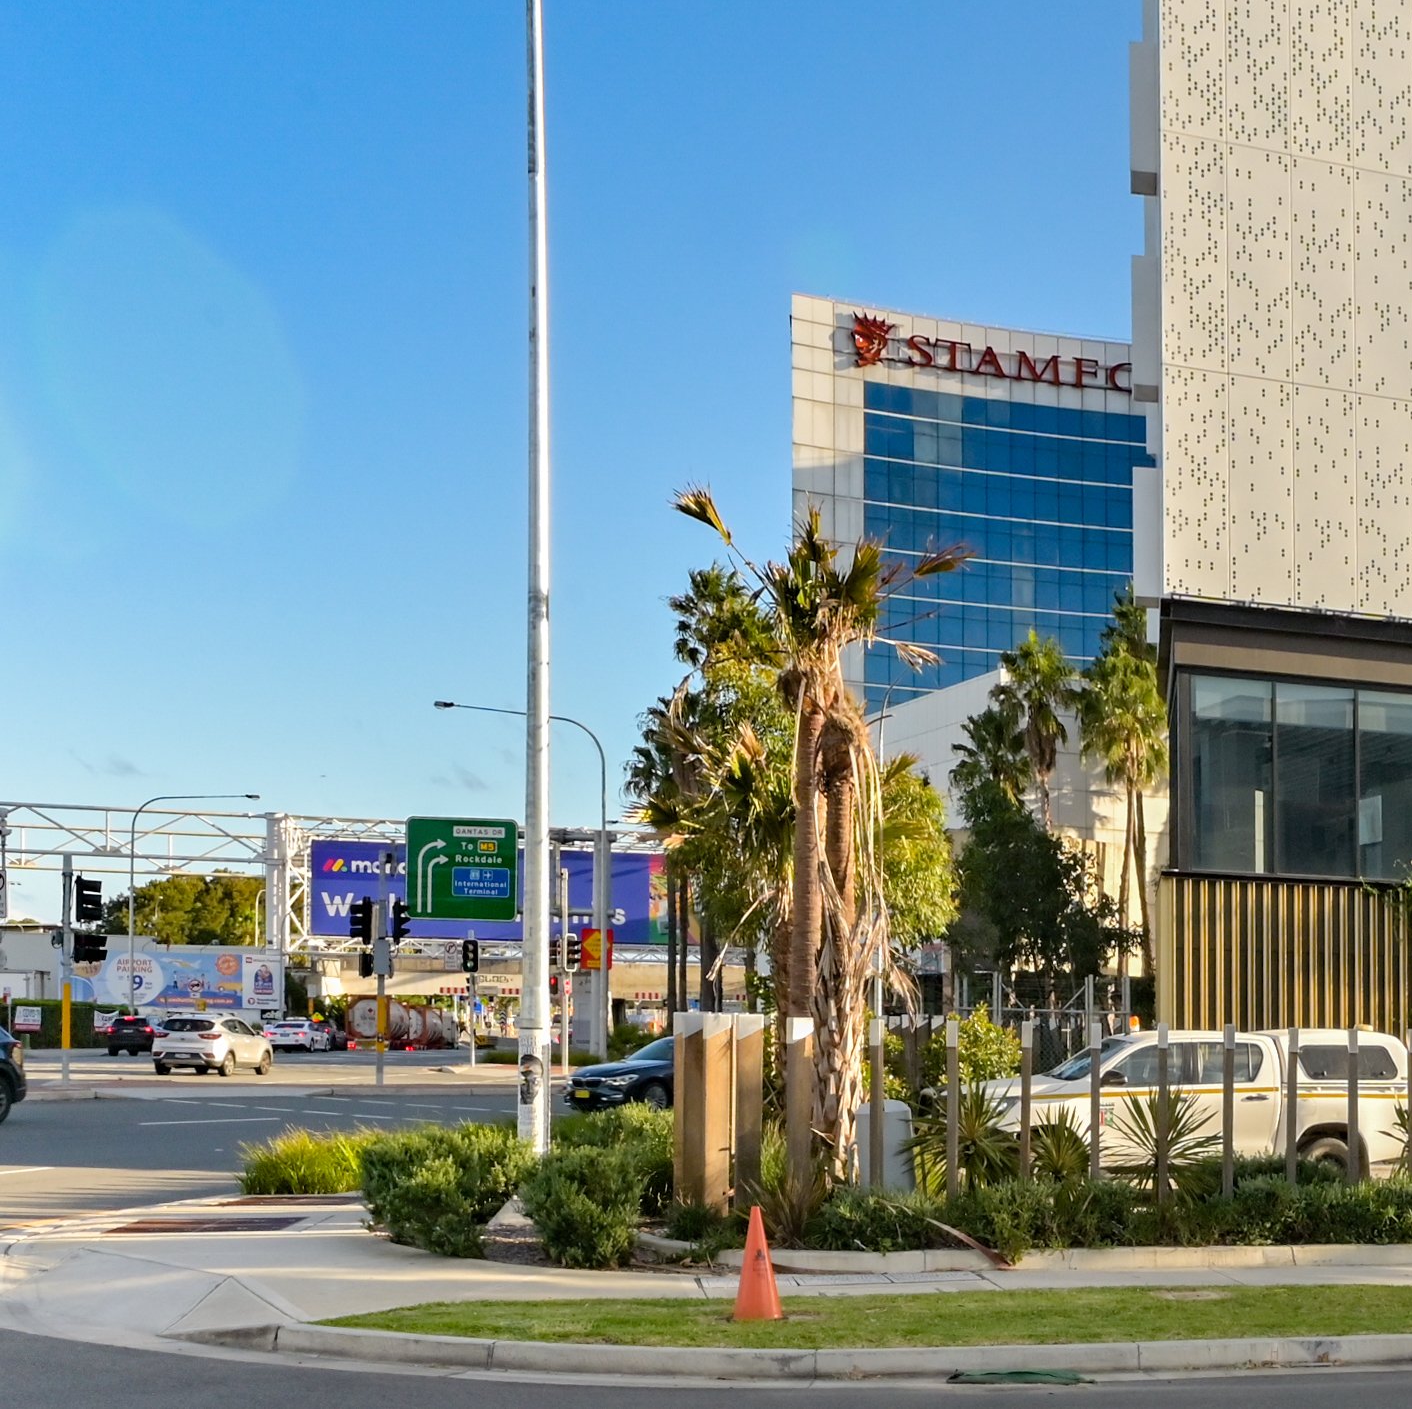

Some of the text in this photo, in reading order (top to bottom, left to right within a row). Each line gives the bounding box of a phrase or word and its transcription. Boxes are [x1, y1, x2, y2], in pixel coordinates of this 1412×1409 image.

[461, 842, 495, 851] To M5
[455, 854, 503, 864] Rockdale
[455, 880, 507, 888] International
